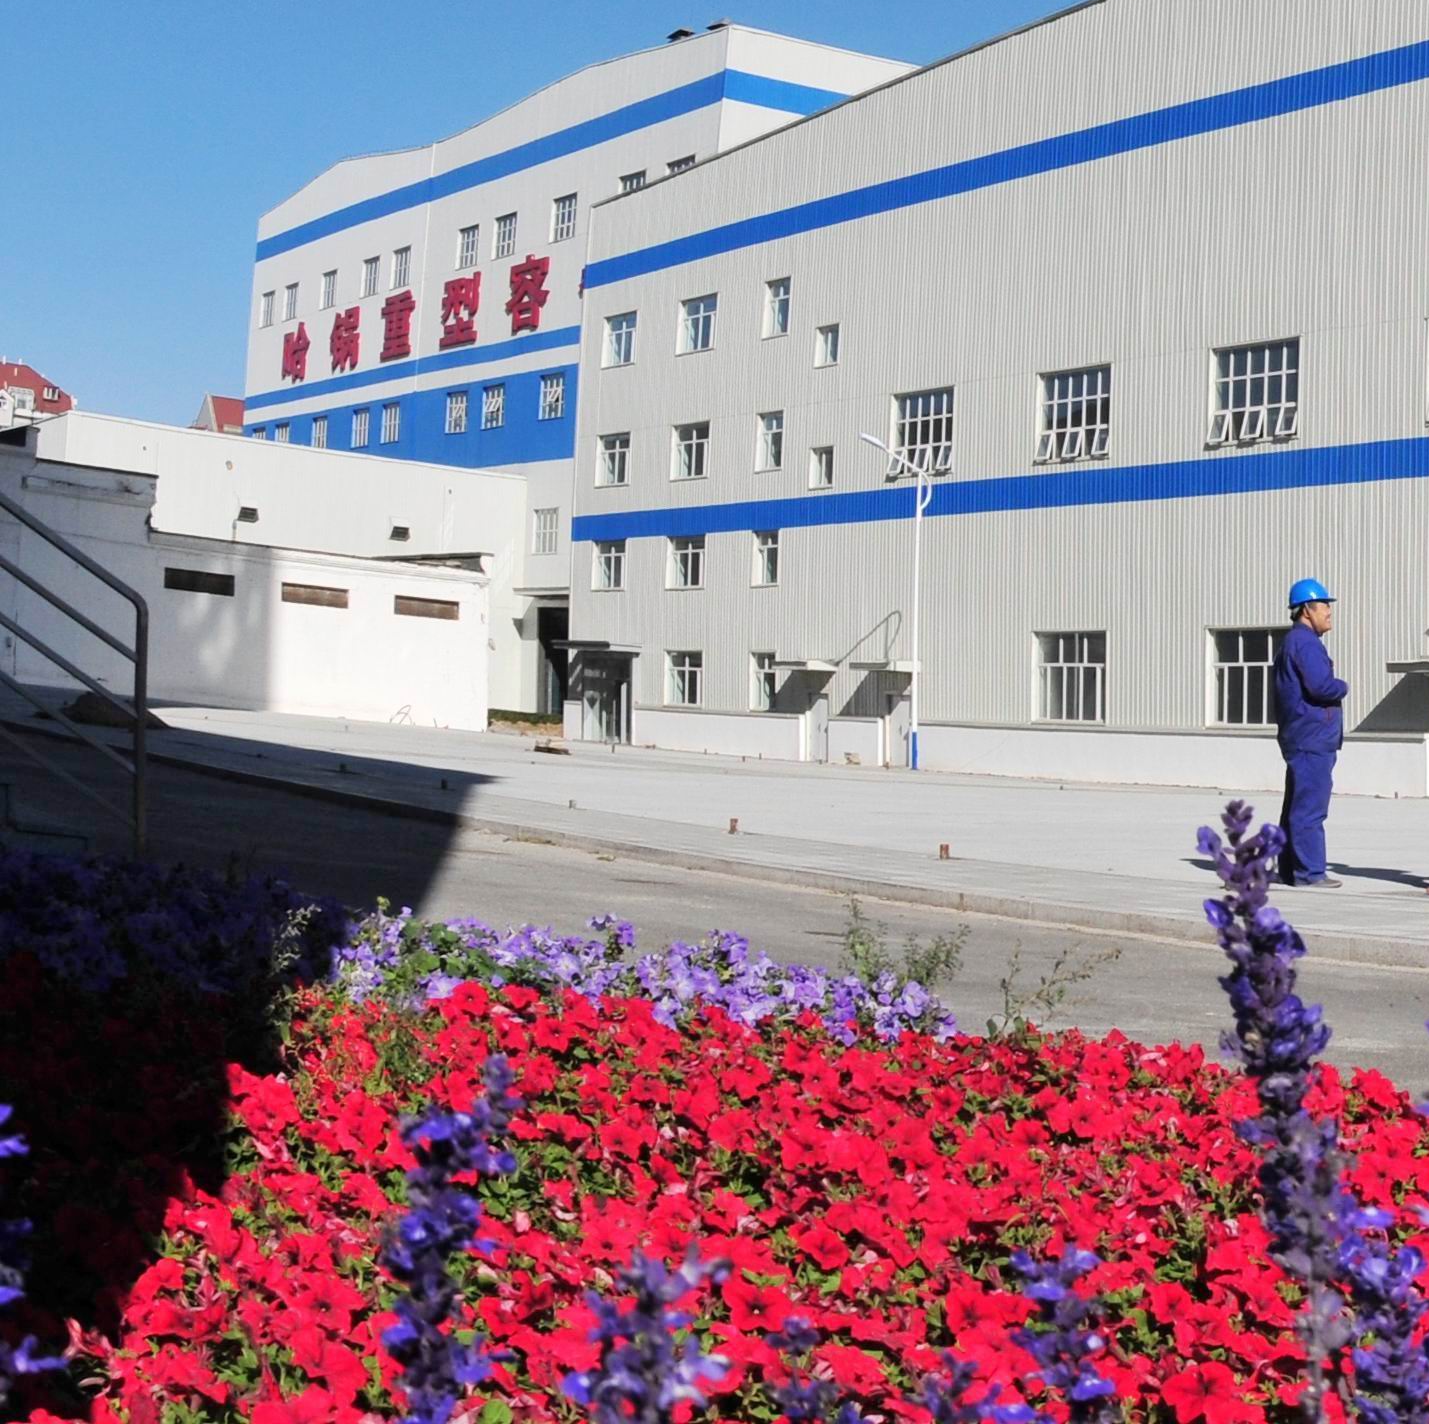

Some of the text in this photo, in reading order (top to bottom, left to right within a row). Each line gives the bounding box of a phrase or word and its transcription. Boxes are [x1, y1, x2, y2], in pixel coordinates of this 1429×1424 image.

[282, 253, 586, 382] 哈锅重型容
